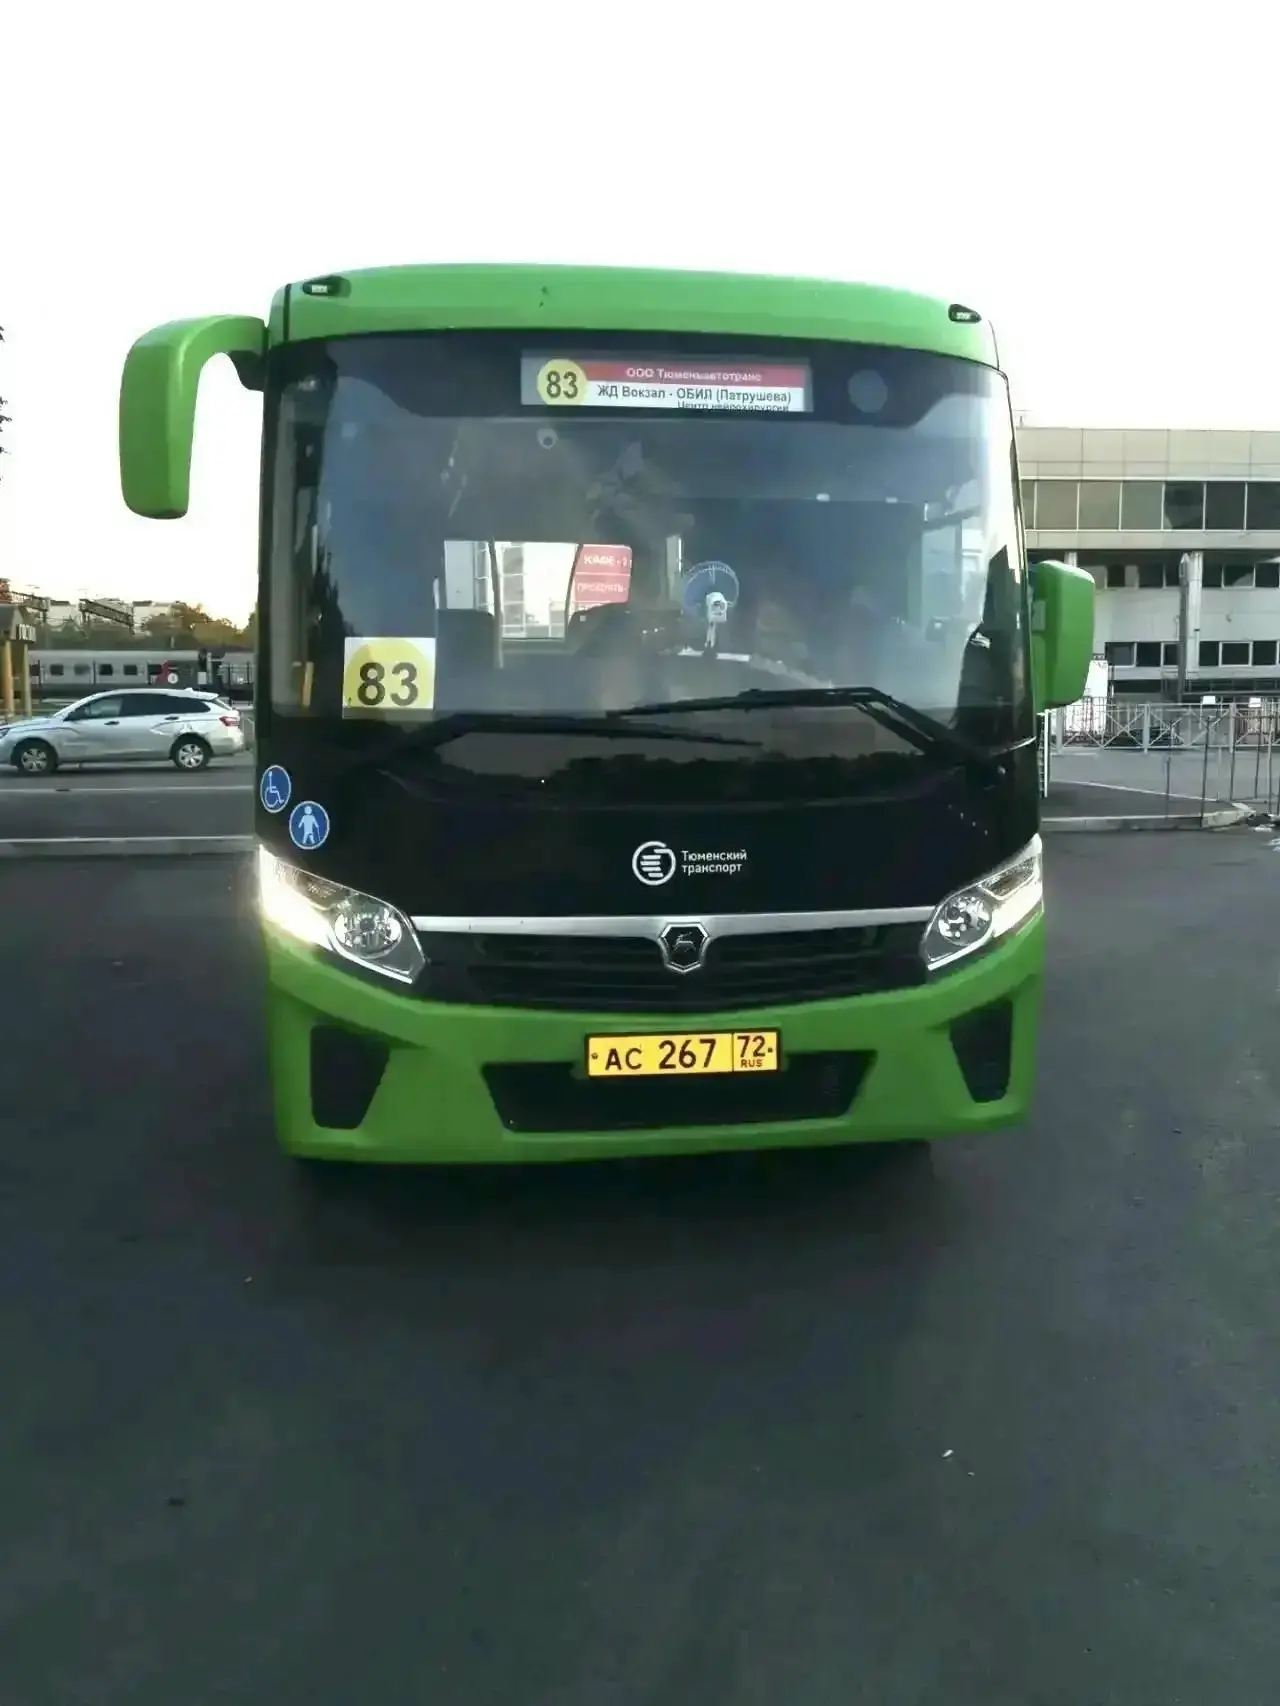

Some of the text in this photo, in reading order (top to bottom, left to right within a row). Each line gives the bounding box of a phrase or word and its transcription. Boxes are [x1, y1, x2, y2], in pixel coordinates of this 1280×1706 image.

[626, 367, 655, 378] ООО
[546, 370, 579, 399] 83
[597, 384, 619, 398] ЖД
[622, 385, 666, 399] Вокзал
[716, 388, 792, 404] (Патрушева)
[357, 662, 419, 706] 83
[681, 849, 748, 862] Тюменский
[681, 863, 743, 876] транспорт
[658, 1038, 717, 1070] 267
[737, 1034, 766, 1058] 72
[740, 1058, 764, 1068] RUS
